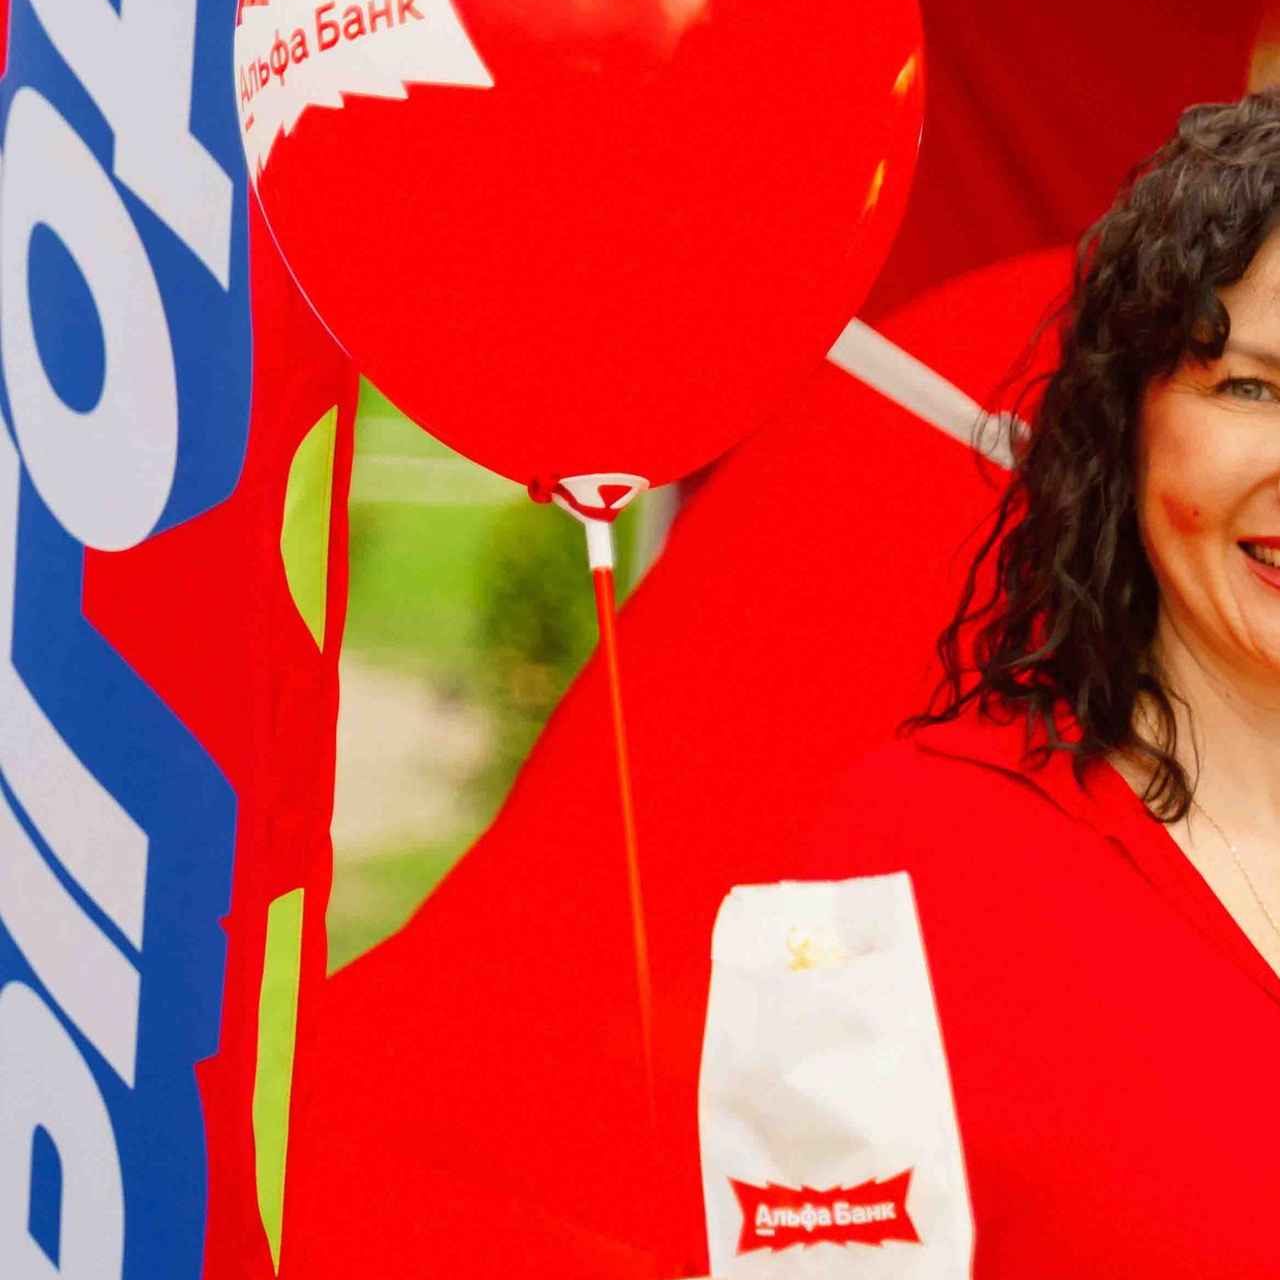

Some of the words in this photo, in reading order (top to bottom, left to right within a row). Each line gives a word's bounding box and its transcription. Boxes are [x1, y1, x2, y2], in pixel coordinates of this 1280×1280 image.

[239, 27, 309, 114] Альфа
[755, 1203, 832, 1233] Альфа
[833, 1201, 897, 1226] Банк
